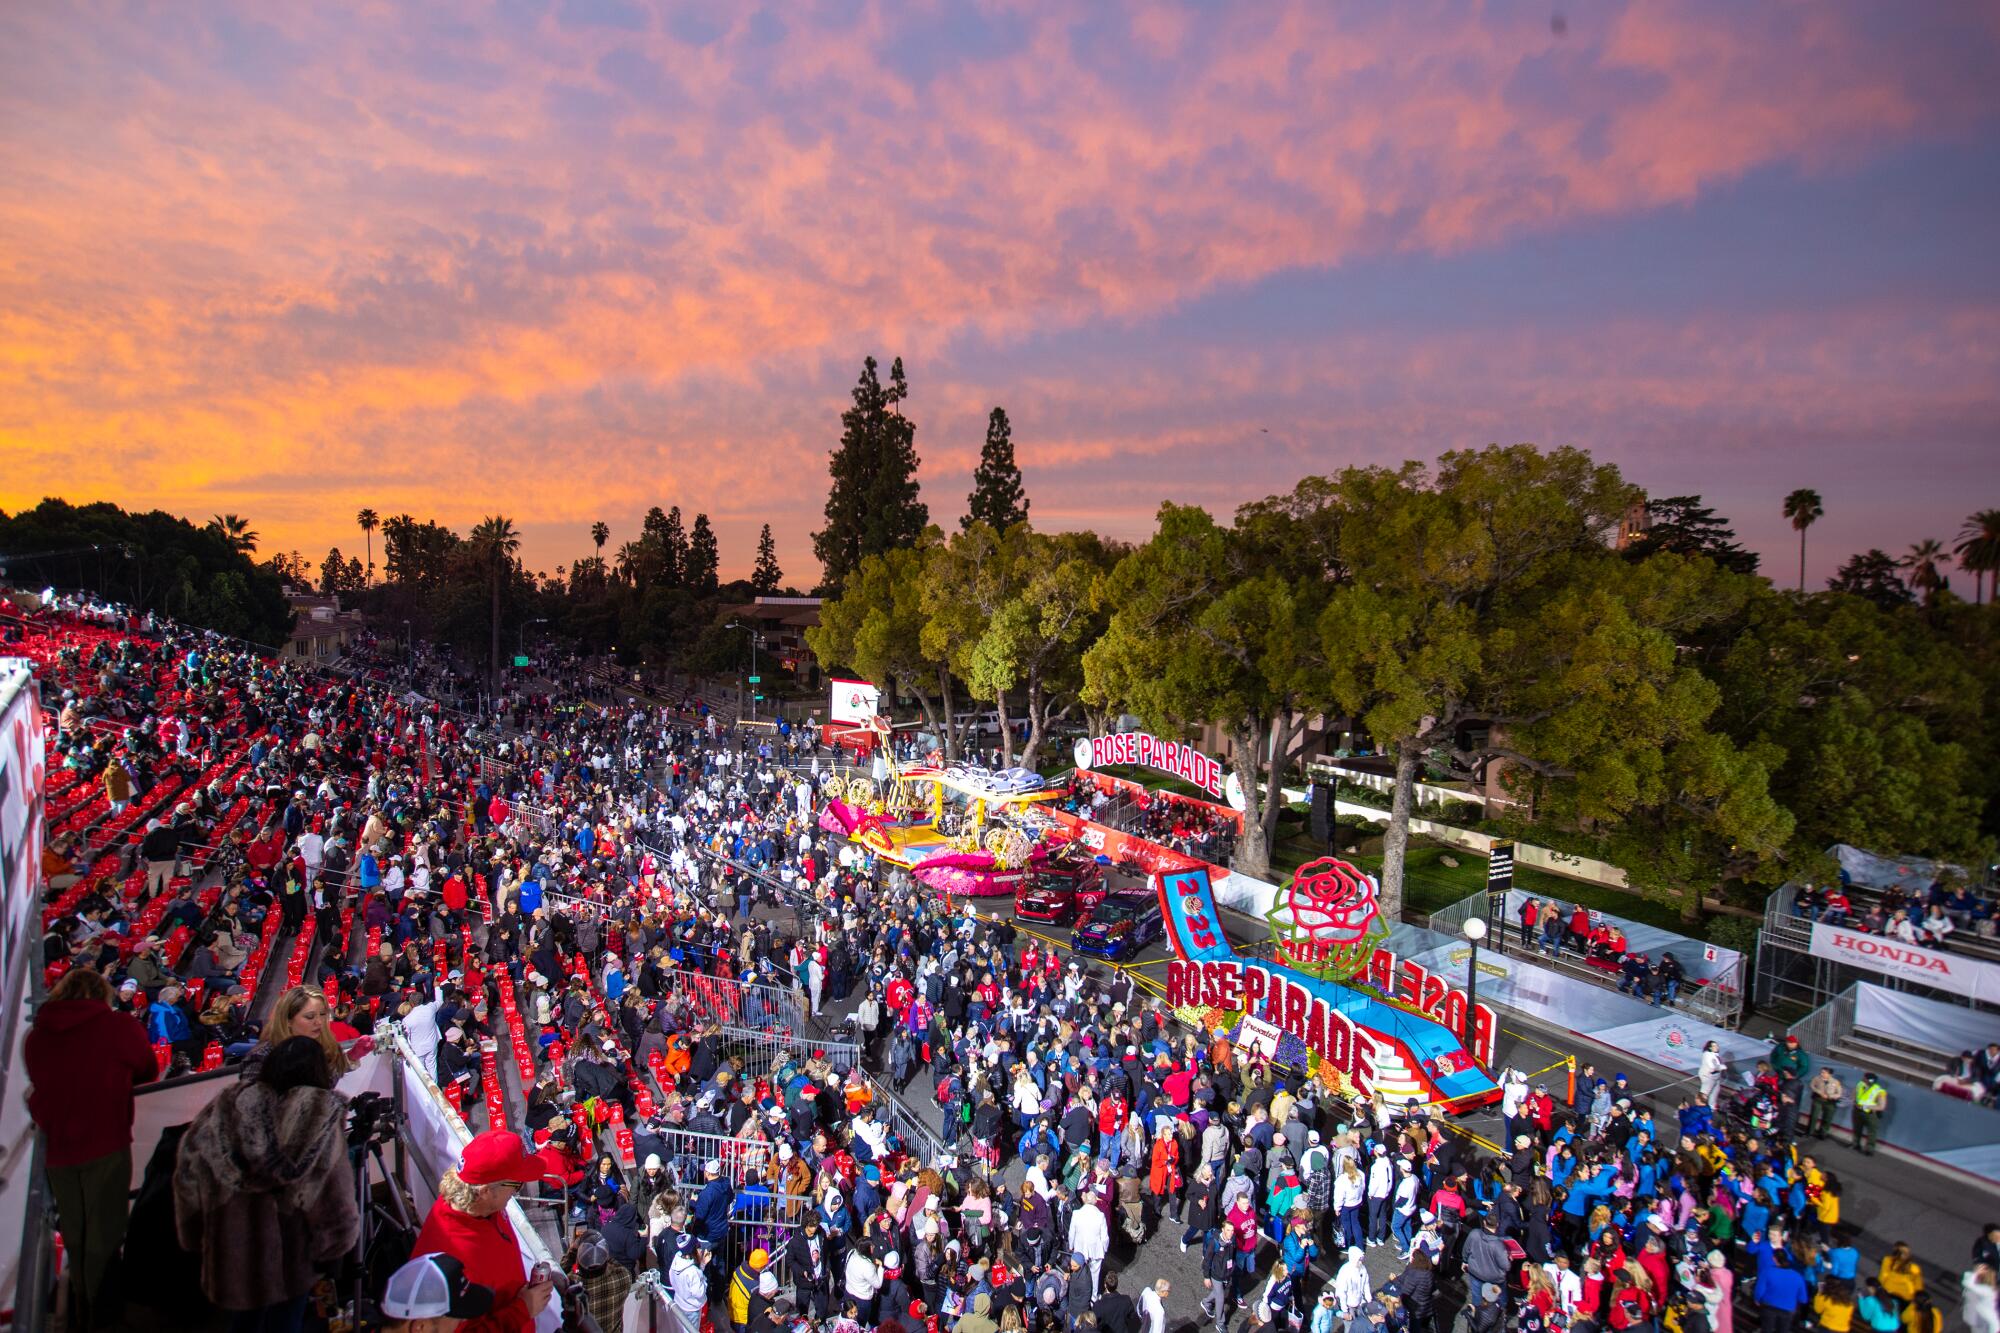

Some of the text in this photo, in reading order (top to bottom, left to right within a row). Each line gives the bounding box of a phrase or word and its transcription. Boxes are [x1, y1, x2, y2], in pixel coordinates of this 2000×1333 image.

[1092, 733, 1223, 799] ROSE PARADE
[1706, 949, 1715, 961] 4
[1832, 933, 1952, 975] HONDA
[1838, 949, 1857, 961] The
[1858, 954, 1887, 971] Power
[1888, 963, 1900, 972] of
[984, 990, 994, 1002] 11
[1166, 959, 1381, 1098] ROSE PARADE
[1243, 1020, 1279, 1041] Presented
